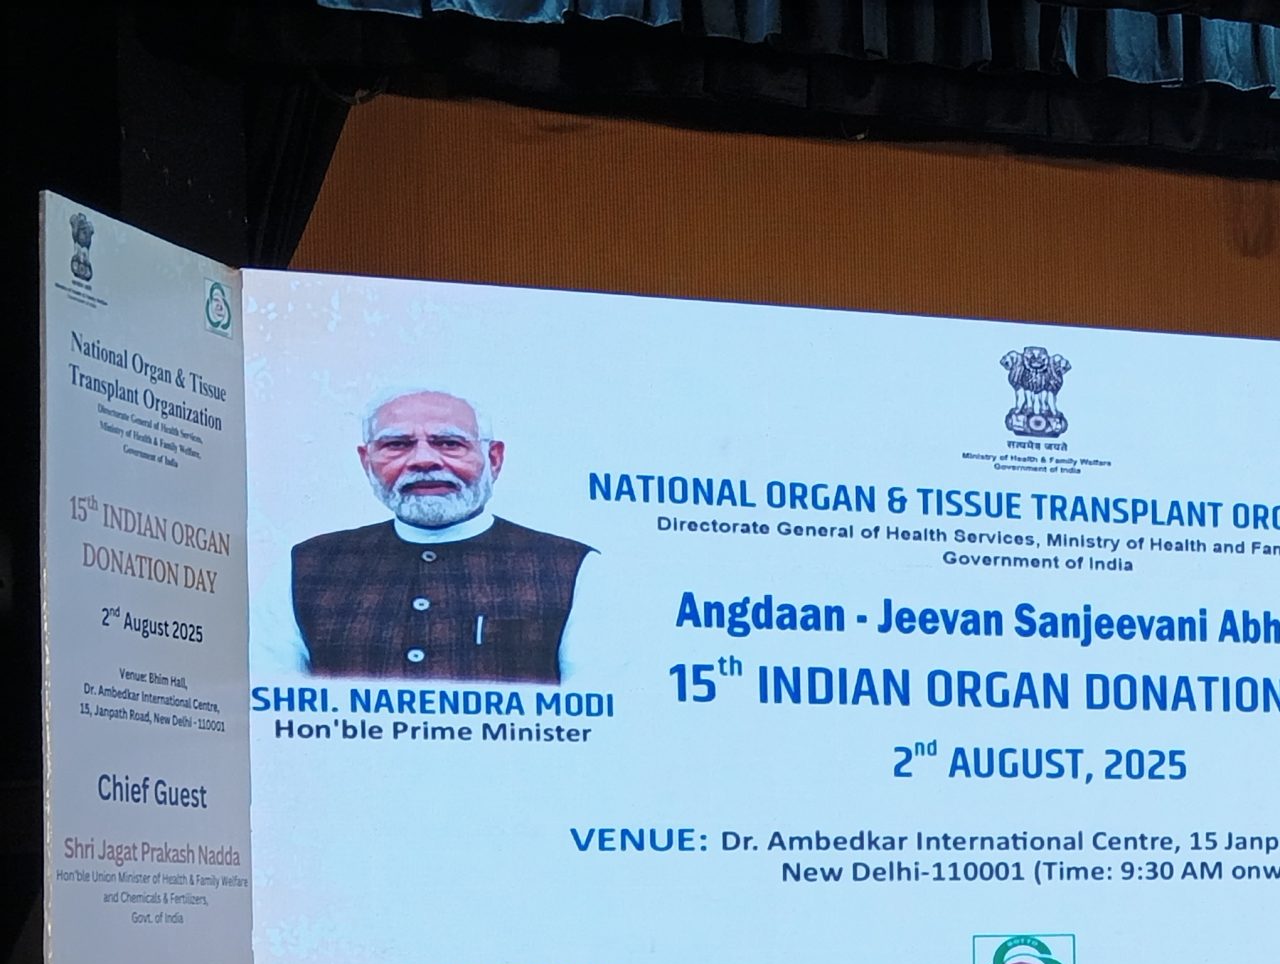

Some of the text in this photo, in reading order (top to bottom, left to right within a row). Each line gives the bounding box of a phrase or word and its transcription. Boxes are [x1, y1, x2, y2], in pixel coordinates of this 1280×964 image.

[71, 331, 226, 402] National Organ & Tissue
[68, 363, 222, 431] Transplant Organization
[589, 472, 756, 508] NATIONAL
[766, 481, 875, 513] ORGAN
[888, 487, 908, 514] &
[916, 488, 1021, 519] TISSUE
[1031, 494, 1223, 528] TRANSPLANT
[657, 516, 770, 535] Directorate
[777, 521, 853, 538] General
[861, 525, 880, 539] of
[886, 526, 947, 542] Health
[954, 529, 1040, 548] Services,
[1047, 533, 1120, 552] Ministry
[1126, 537, 1144, 550] of
[1150, 537, 1206, 552] Health
[1213, 541, 1245, 554] and
[123, 612, 170, 639] August
[172, 621, 203, 643] 2025
[676, 592, 845, 637] Angdaan
[857, 615, 867, 623] -
[877, 598, 1003, 636] Jeevan
[1014, 603, 1207, 647] Sanjeevani
[669, 655, 742, 702] 15th
[759, 666, 910, 706] INDIAN
[927, 669, 1069, 709] ORGAN
[252, 687, 613, 717] SHRI. NARENDRA MODI
[275, 719, 592, 742] Hon'ble Prime Minister
[894, 739, 1186, 784] 2nd AUGUST, 2025
[98, 774, 207, 809] Chief Guest
[570, 828, 707, 852] VENUE:
[722, 831, 758, 851] Dr.
[767, 830, 908, 851] Ambedkar
[917, 831, 1083, 851] International
[1092, 832, 1180, 854] Centre,
[1190, 832, 1218, 850] 15
[782, 862, 843, 882] New
[852, 861, 1025, 882] Delhi-110001
[1034, 860, 1112, 885] (Time:
[1121, 861, 1174, 880] 9:30
[1181, 861, 1222, 880] AM
